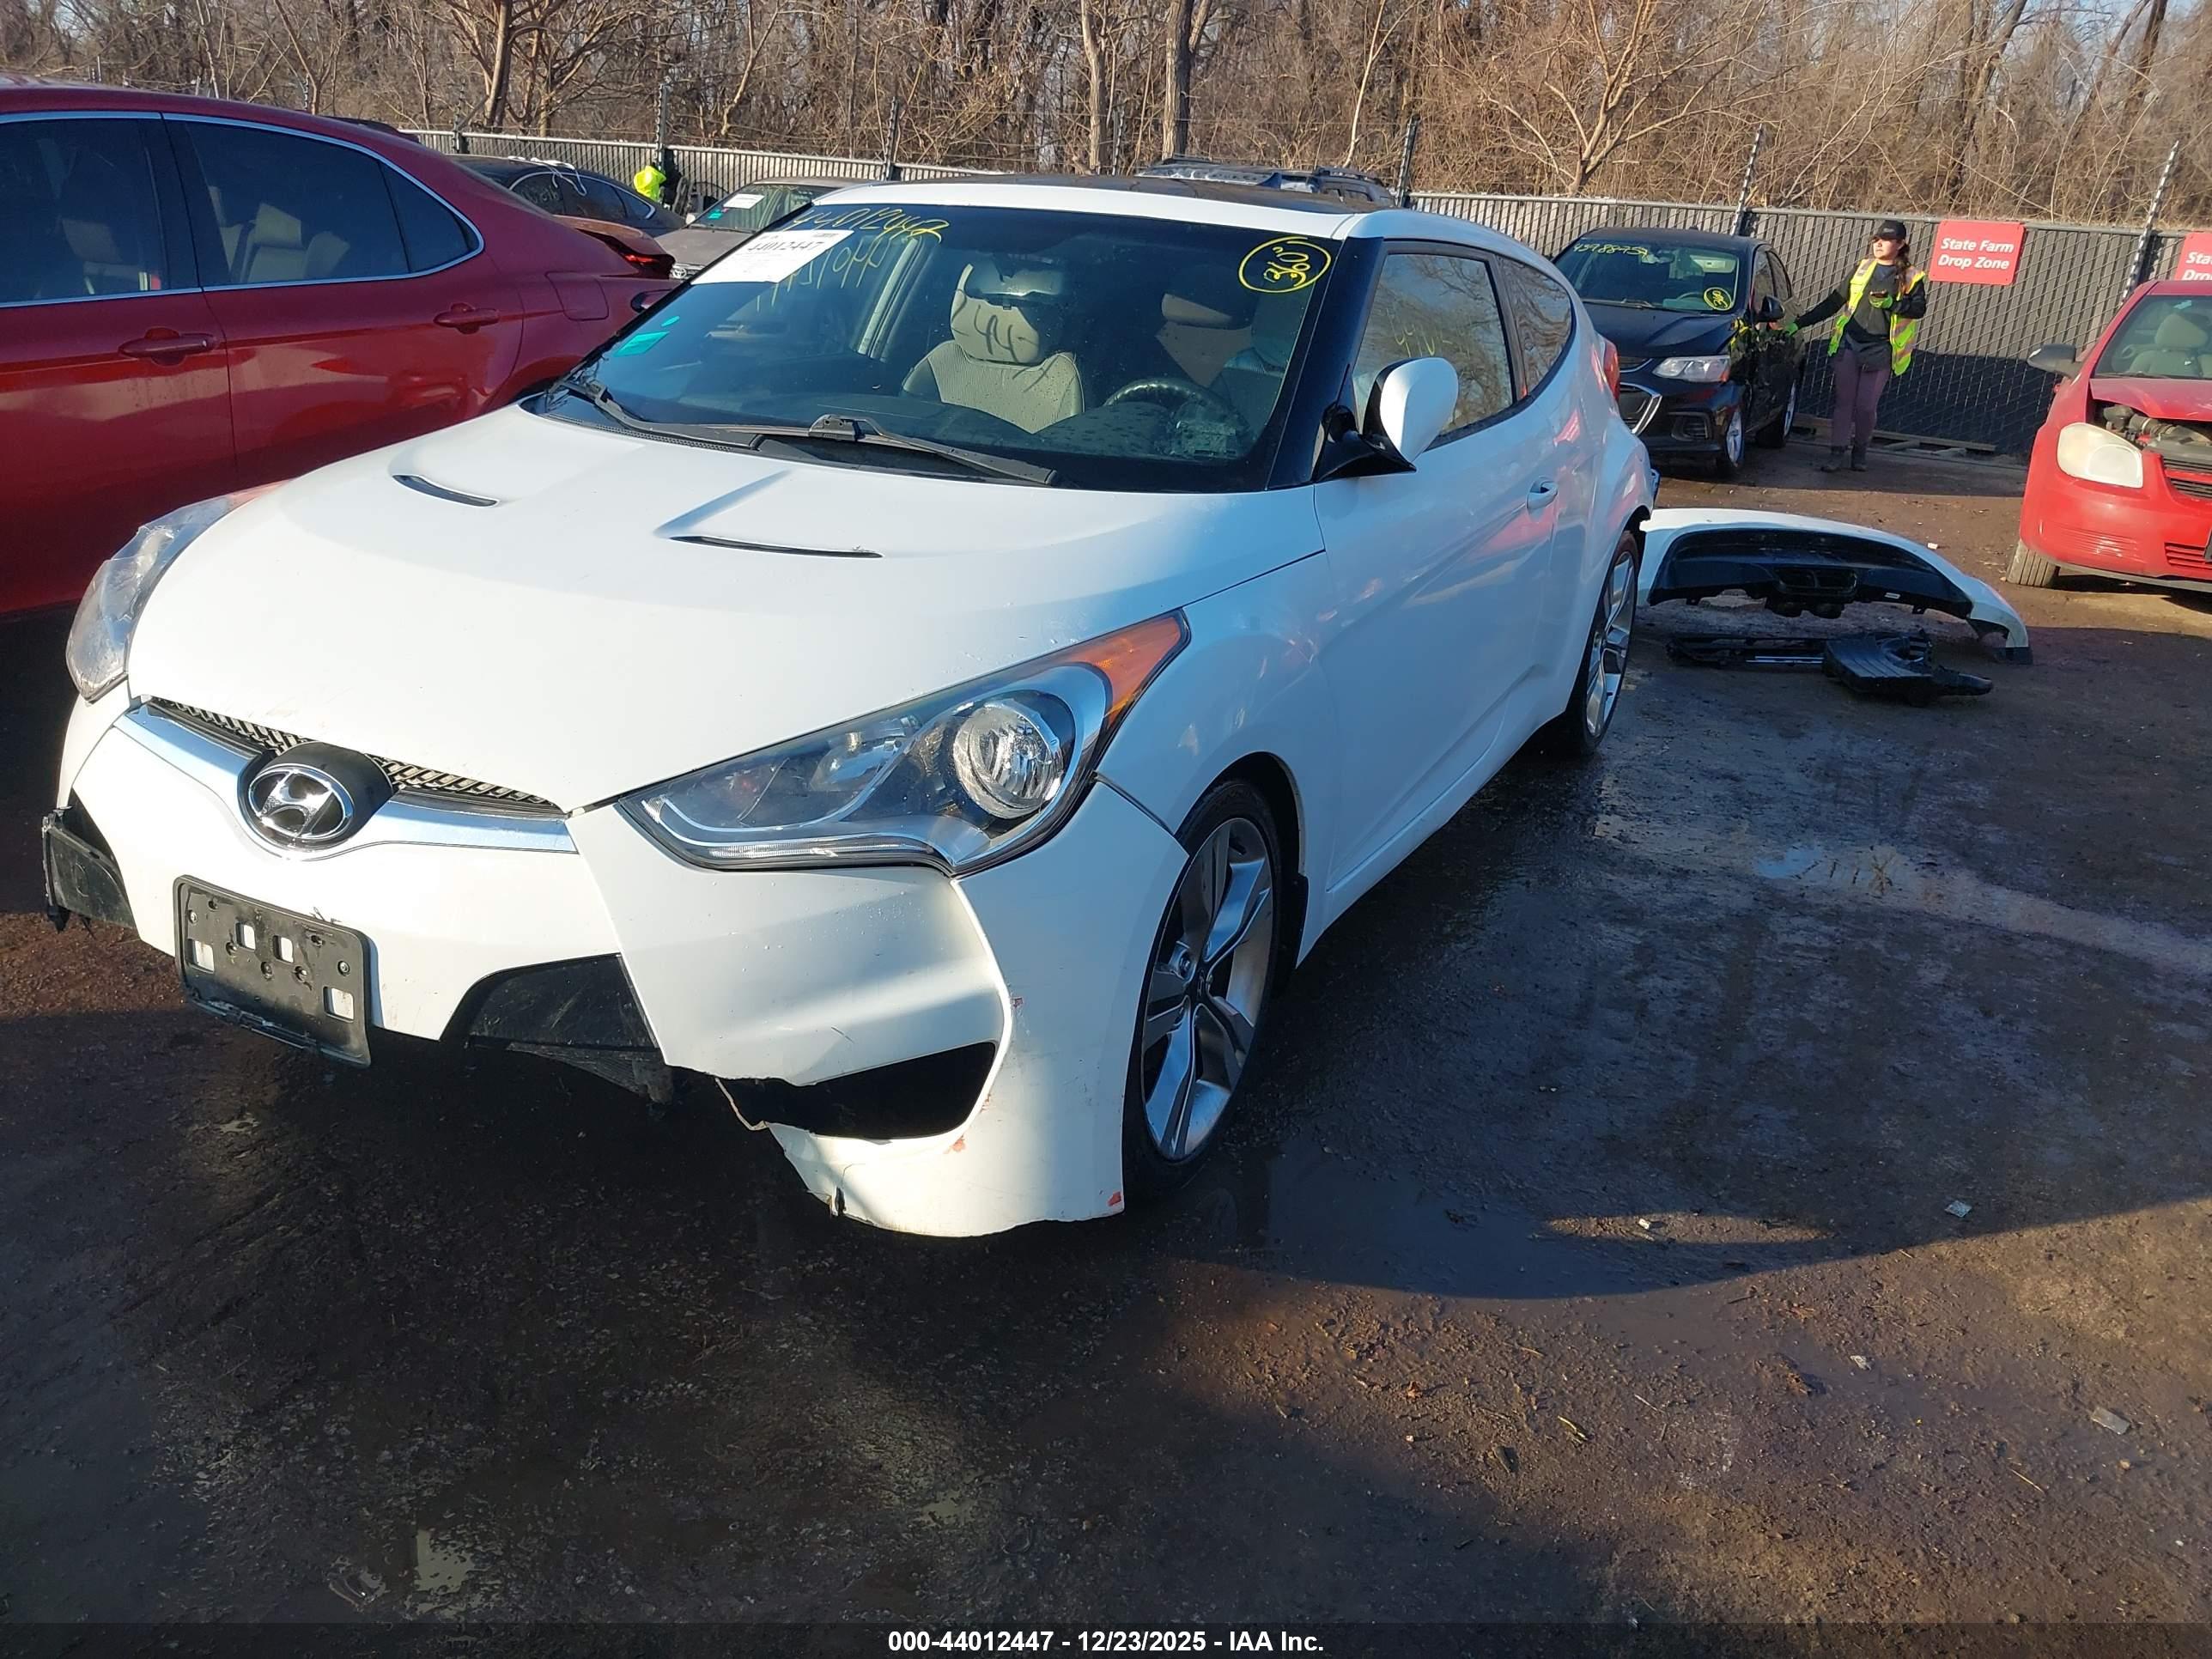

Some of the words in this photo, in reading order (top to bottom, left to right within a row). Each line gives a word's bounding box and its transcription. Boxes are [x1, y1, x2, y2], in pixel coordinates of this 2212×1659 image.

[1941, 237, 1978, 252] State
[1978, 240, 2014, 253] Farm
[1937, 253, 1973, 270] Drop
[1974, 257, 2010, 270] Zone
[2185, 251, 2212, 265] Sta
[2181, 269, 2212, 281] Dro
